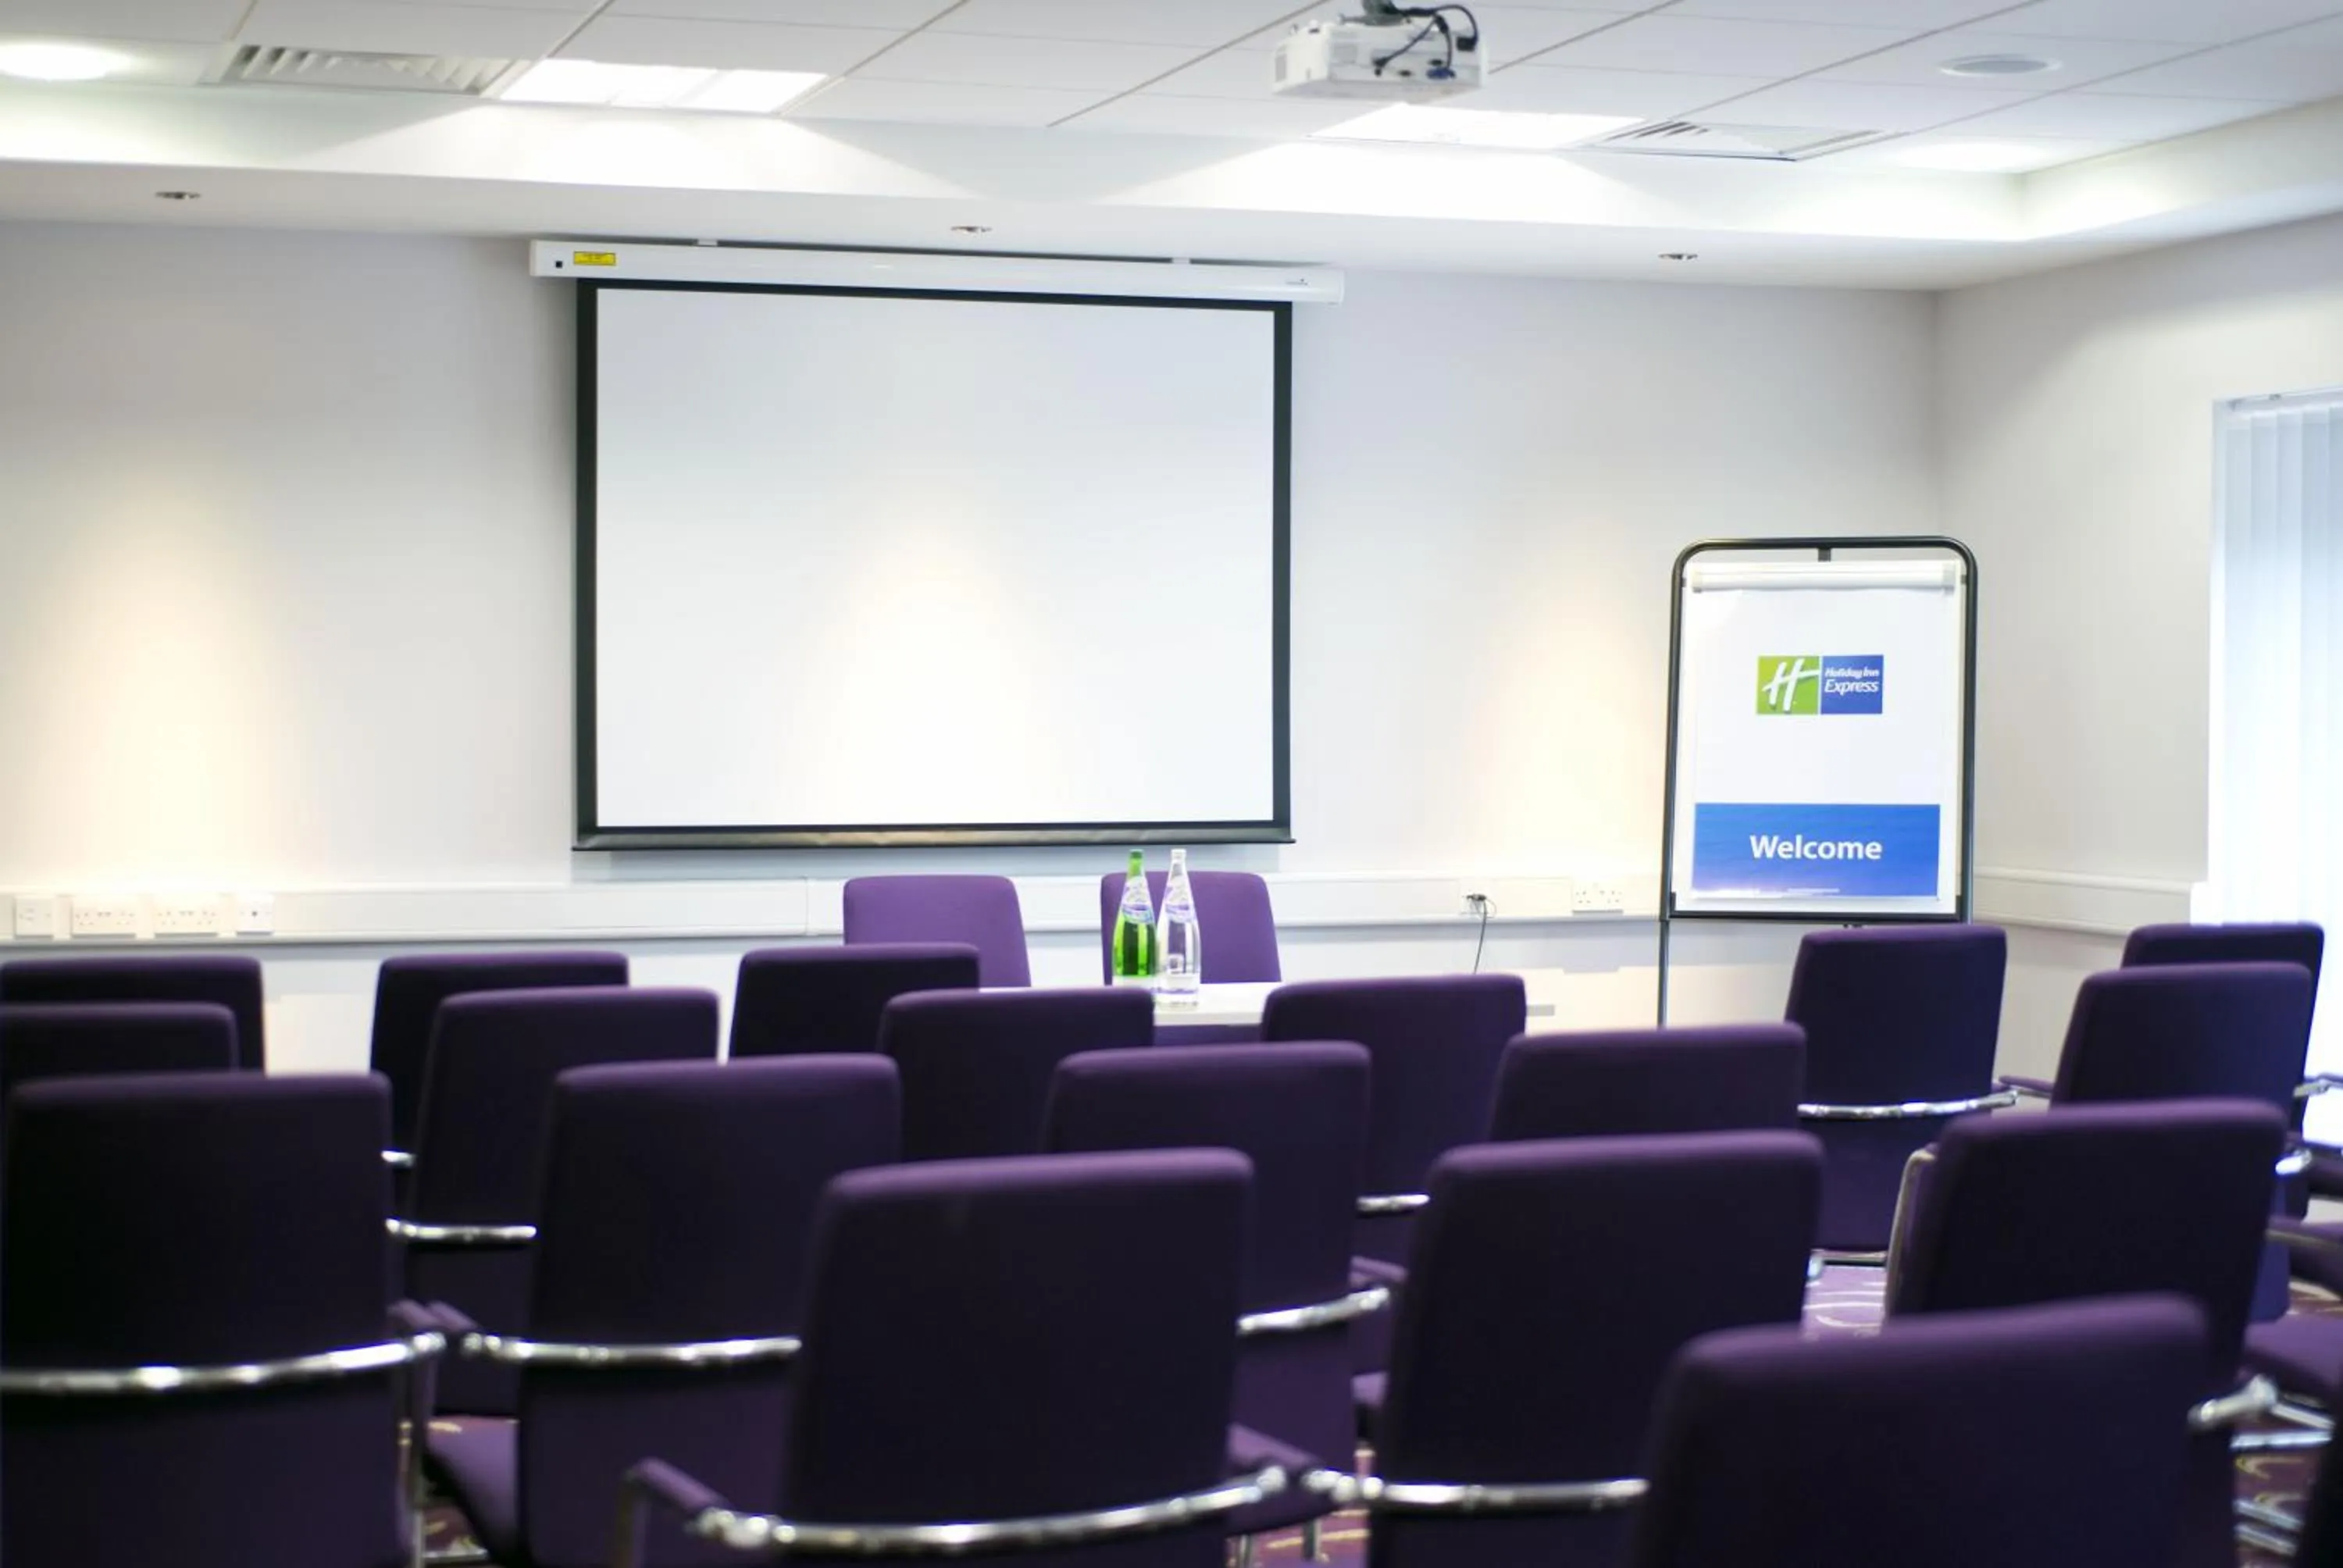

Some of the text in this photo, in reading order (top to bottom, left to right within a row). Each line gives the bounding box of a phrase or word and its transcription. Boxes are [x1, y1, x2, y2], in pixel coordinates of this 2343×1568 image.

[1824, 666, 1880, 679] Holiday Inn
[1824, 679, 1879, 696] Express
[1749, 834, 1882, 860] Welcome
